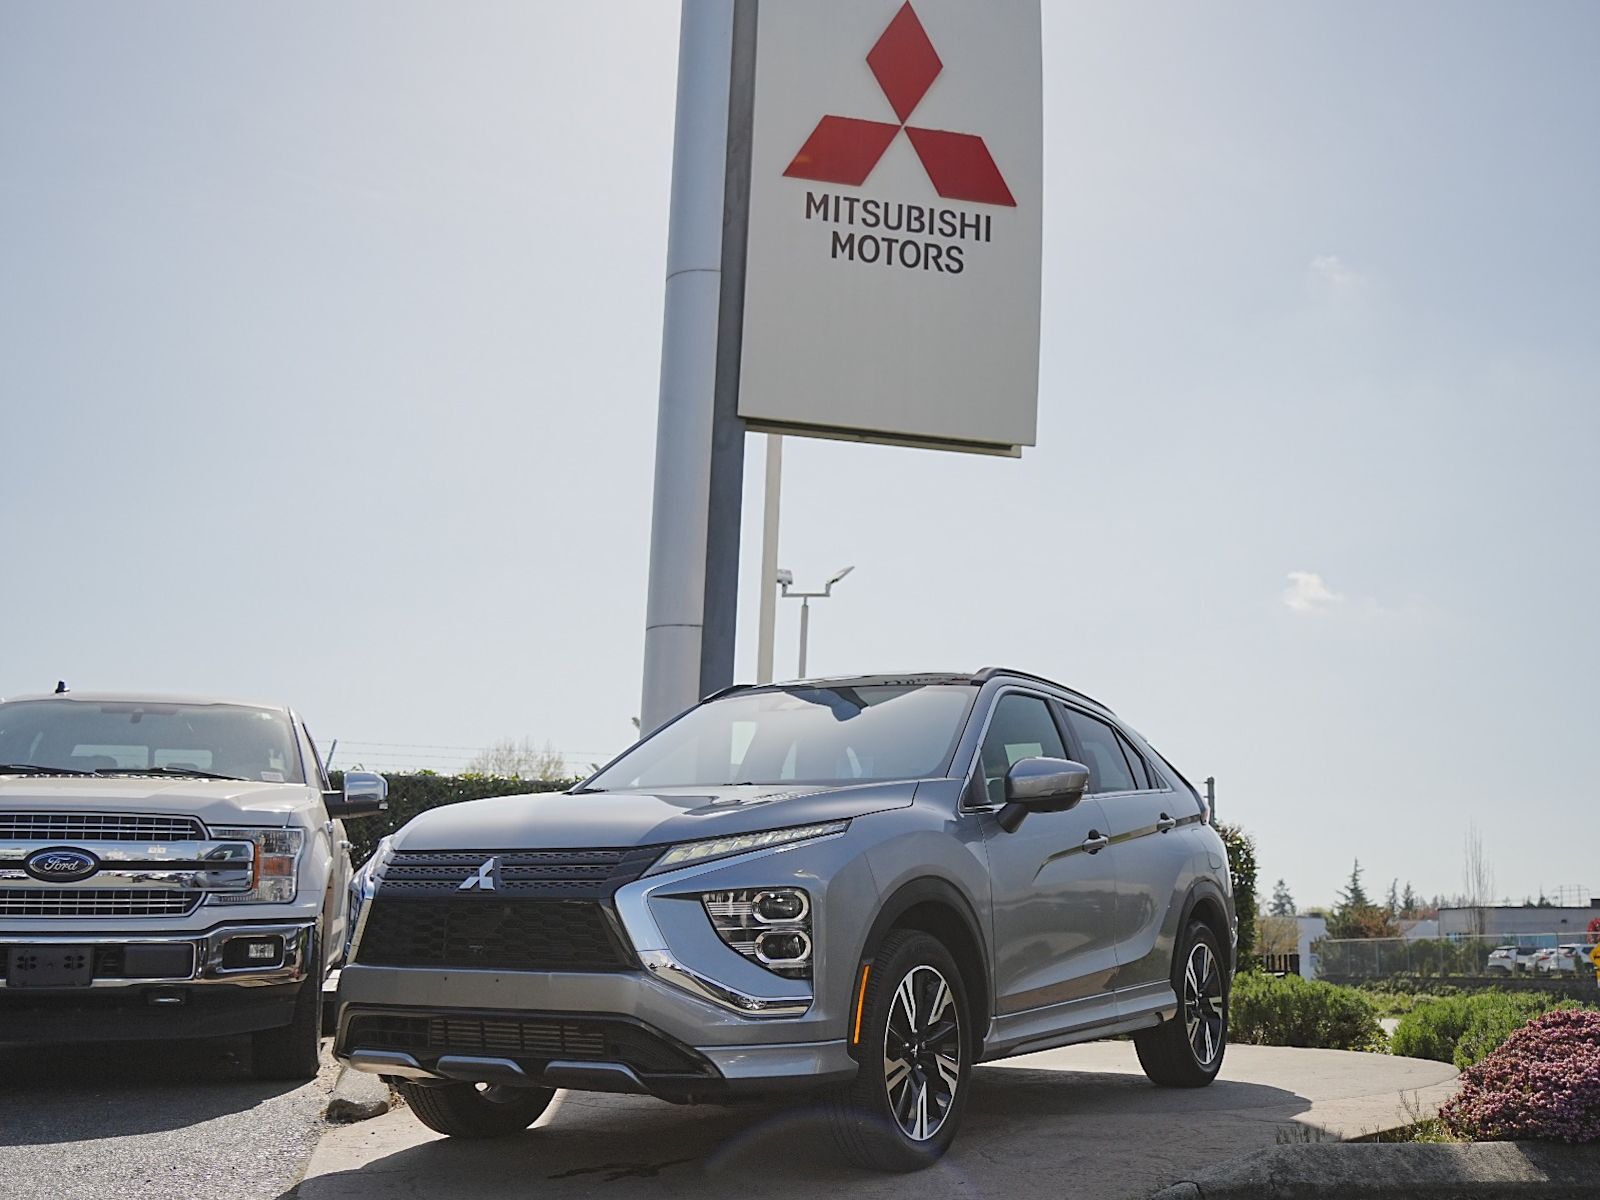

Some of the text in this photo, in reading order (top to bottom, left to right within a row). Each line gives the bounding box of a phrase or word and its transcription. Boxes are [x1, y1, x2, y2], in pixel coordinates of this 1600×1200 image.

[805, 191, 992, 242] MITSUBISHI
[831, 231, 964, 274] MOTORS
[44, 856, 79, 871] Ford
